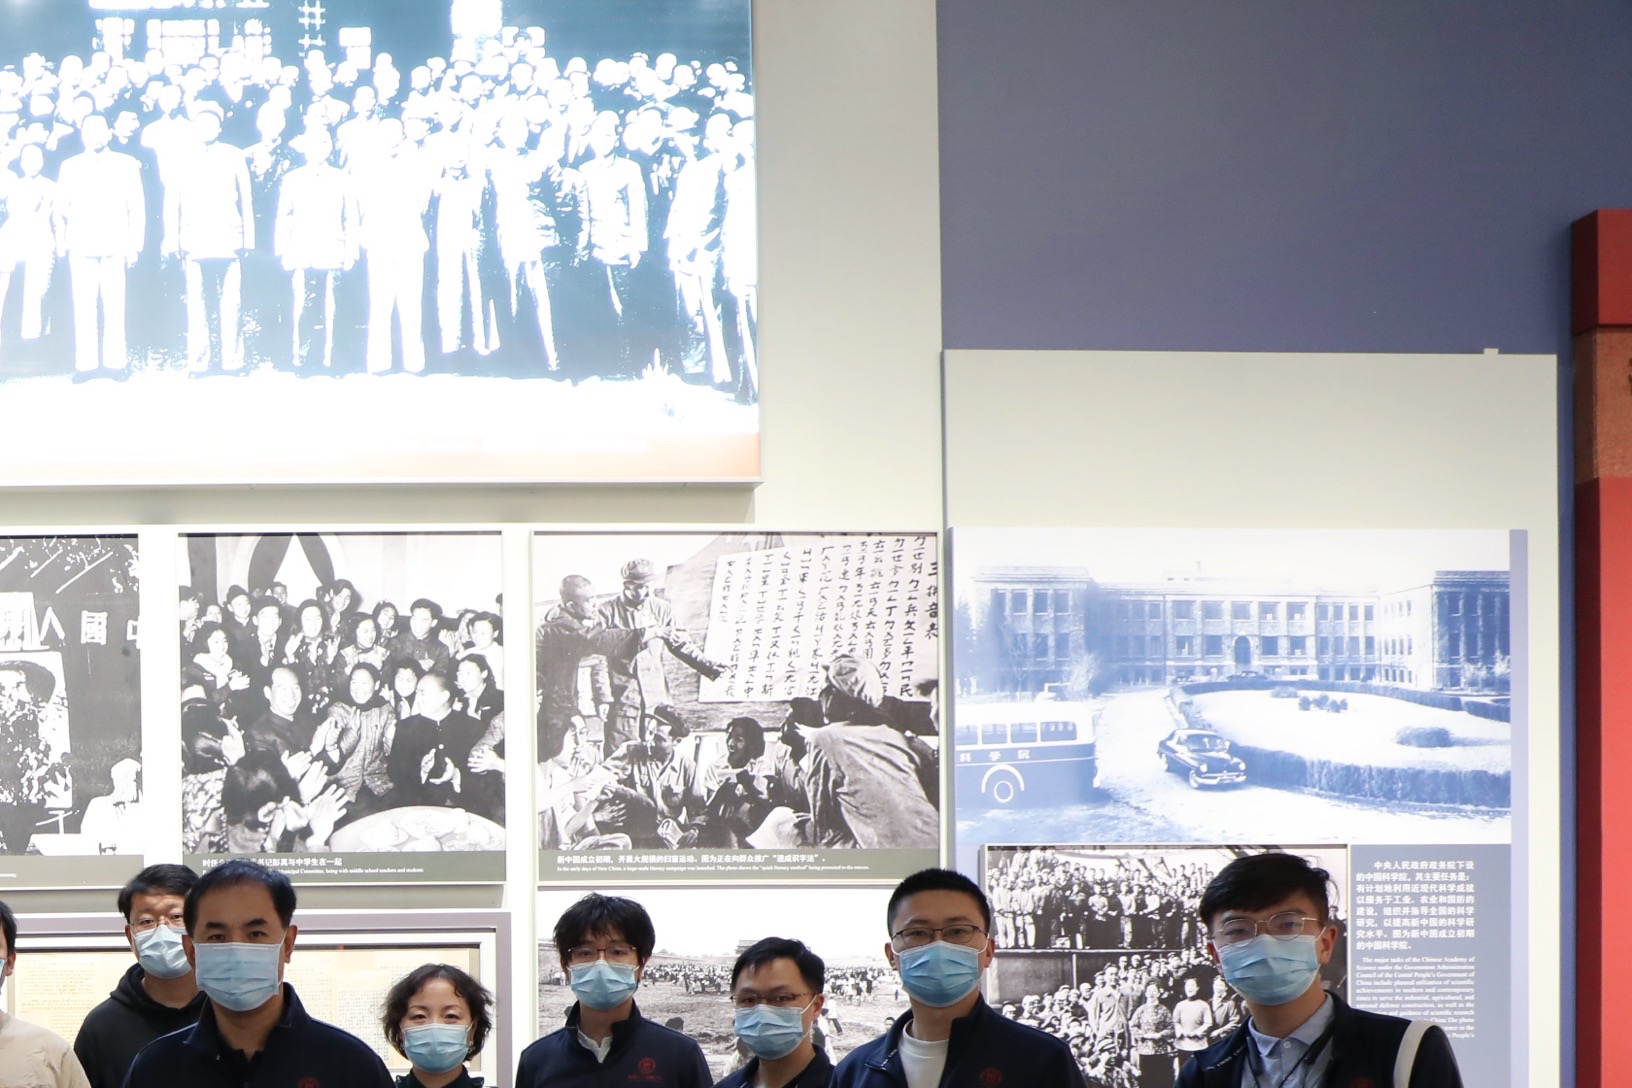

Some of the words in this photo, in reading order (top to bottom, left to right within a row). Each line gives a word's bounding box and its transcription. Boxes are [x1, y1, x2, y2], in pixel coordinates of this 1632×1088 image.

[1374, 861, 1474, 870] 中央人民政府政务院下设
[1356, 884, 1475, 893] 有计划地利用近现代科学成就
